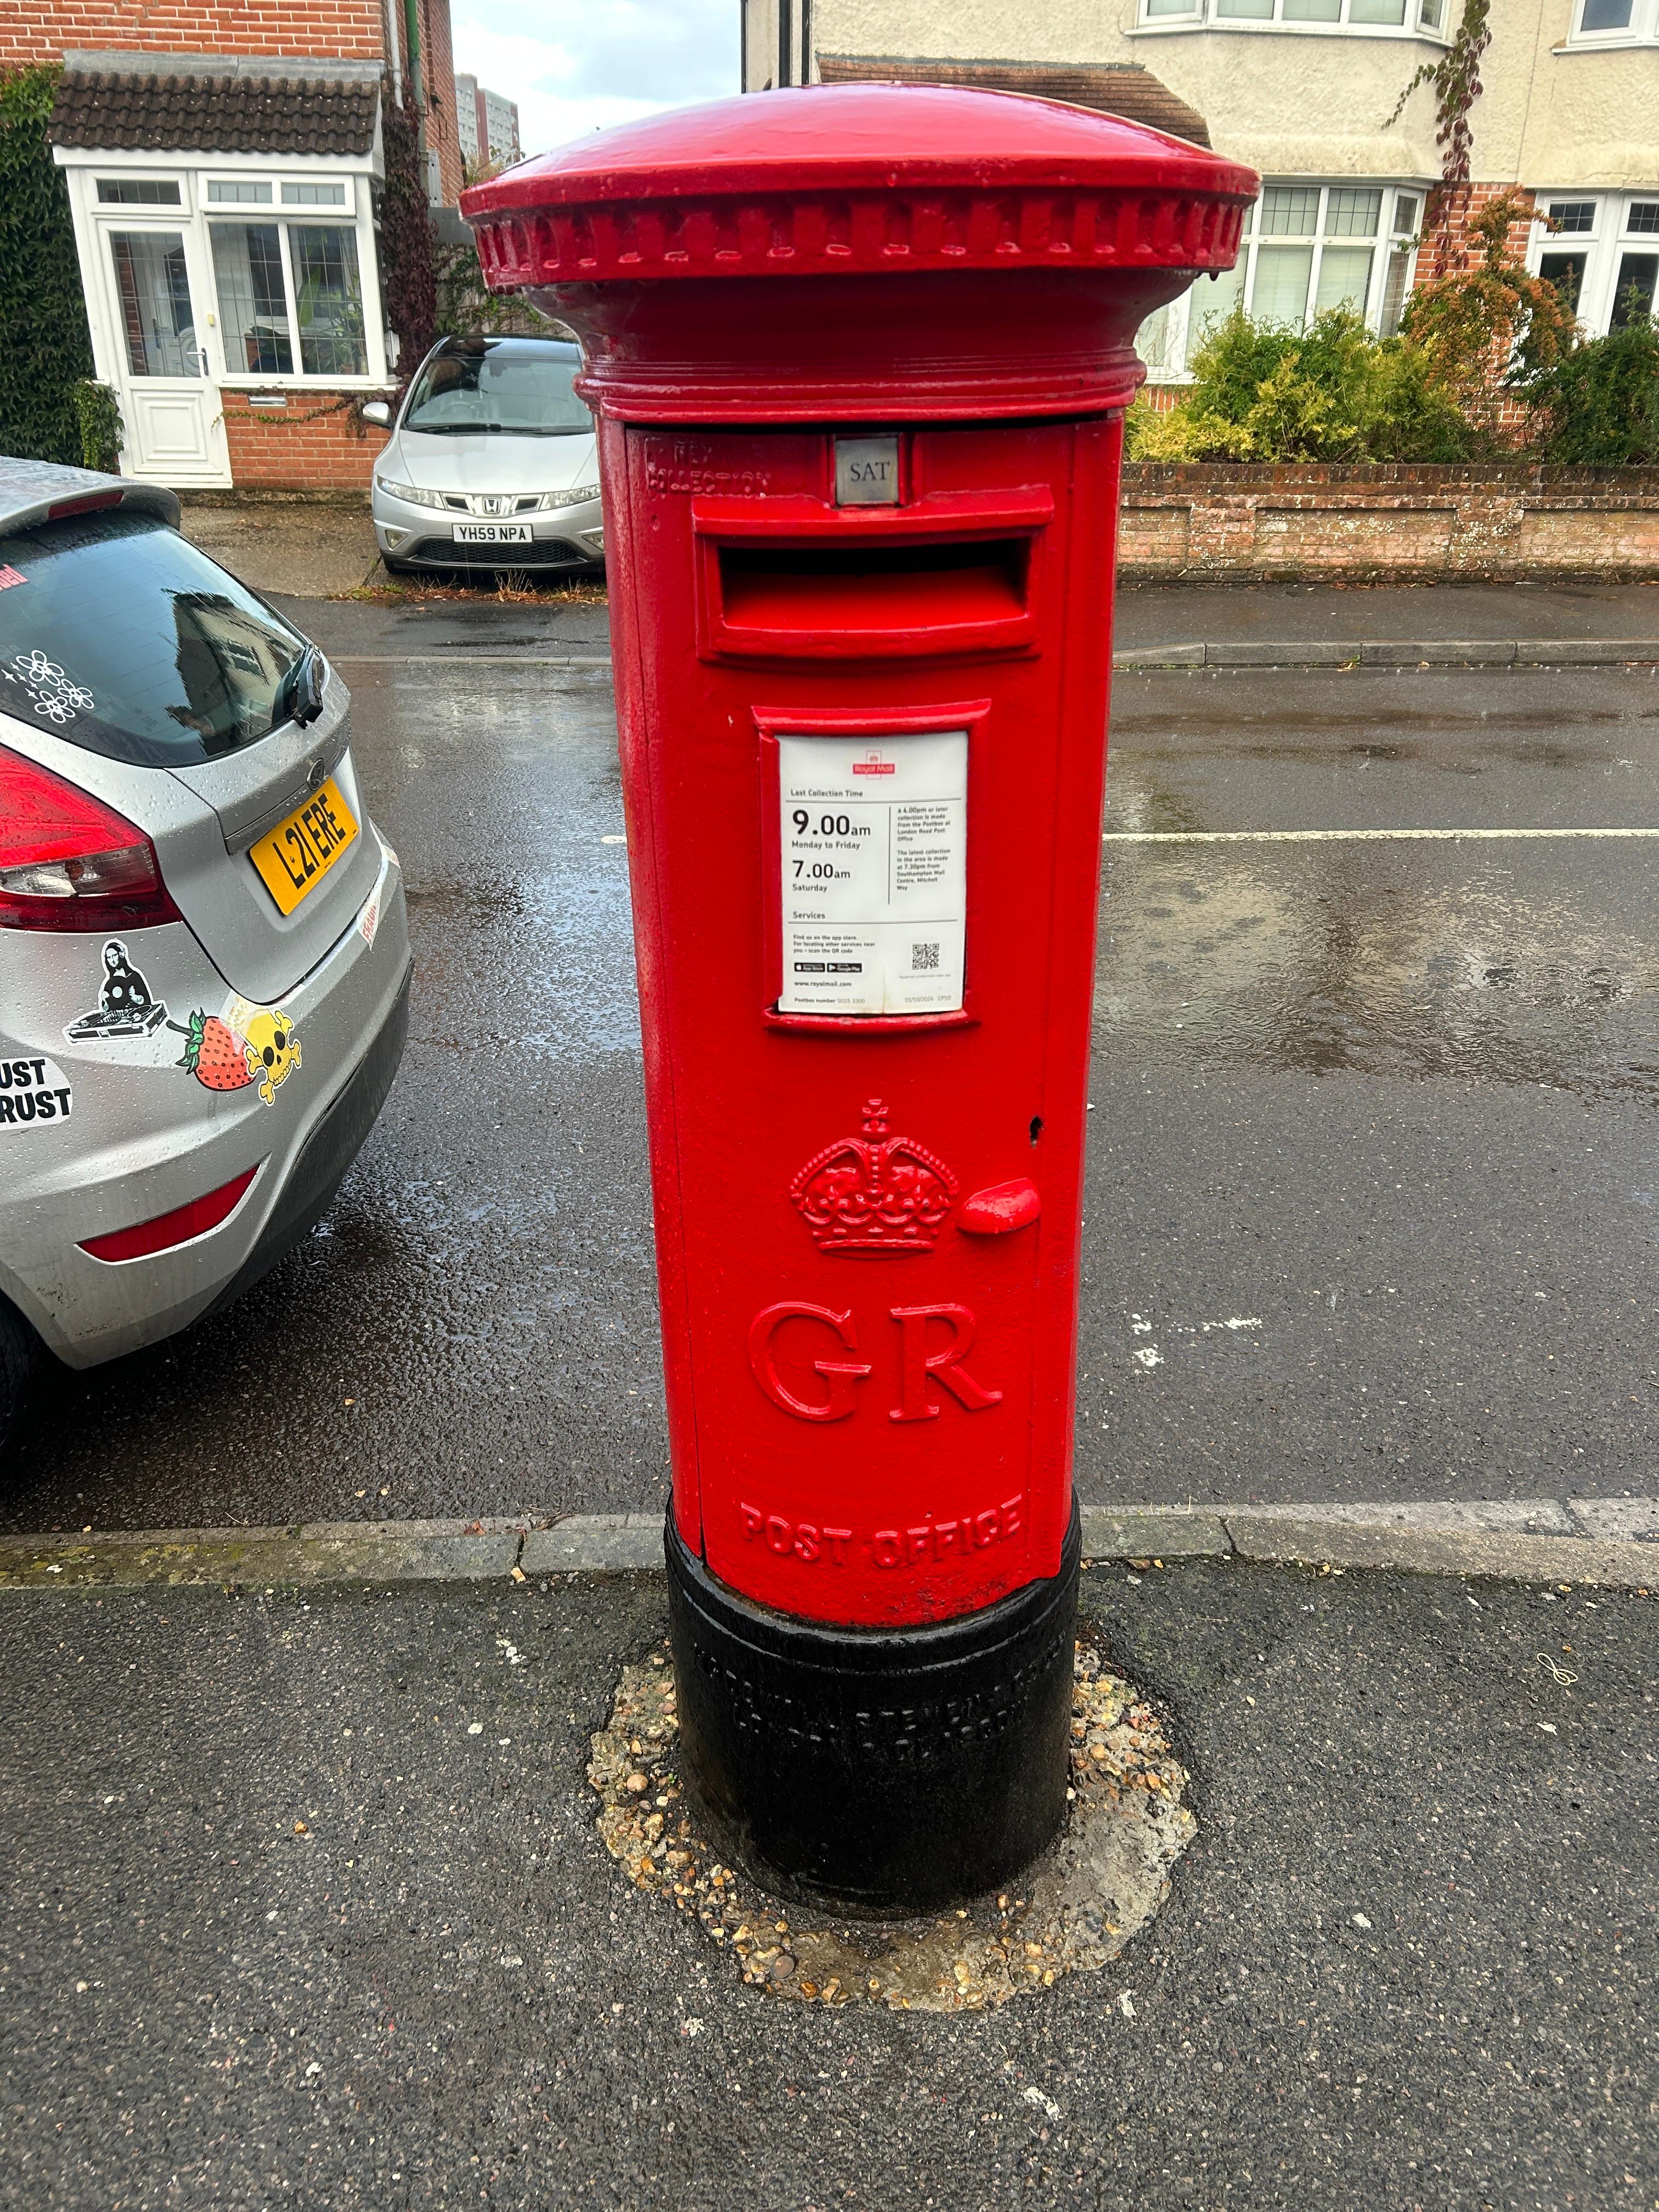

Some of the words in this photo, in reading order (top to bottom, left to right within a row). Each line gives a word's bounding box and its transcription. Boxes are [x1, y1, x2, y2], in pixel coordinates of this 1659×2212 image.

[850, 461, 890, 482] SAT
[459, 527, 495, 540] YH59
[499, 527, 526, 540] NPA
[855, 765, 876, 774] Royal
[877, 765, 894, 773] Mail
[791, 788, 806, 797] Last
[808, 788, 843, 797] Collection
[845, 789, 863, 797] Time
[793, 810, 871, 836] 9.00am
[792, 840, 822, 850] Monday
[825, 840, 833, 849] to
[836, 841, 860, 850] Friday
[792, 860, 850, 879] 7.00am
[792, 883, 827, 893] Saturday
[793, 911, 826, 919] Services
[747, 1301, 1003, 1424] GR
[740, 1502, 852, 1565] POST
[875, 1493, 1022, 1568] OFFICE
